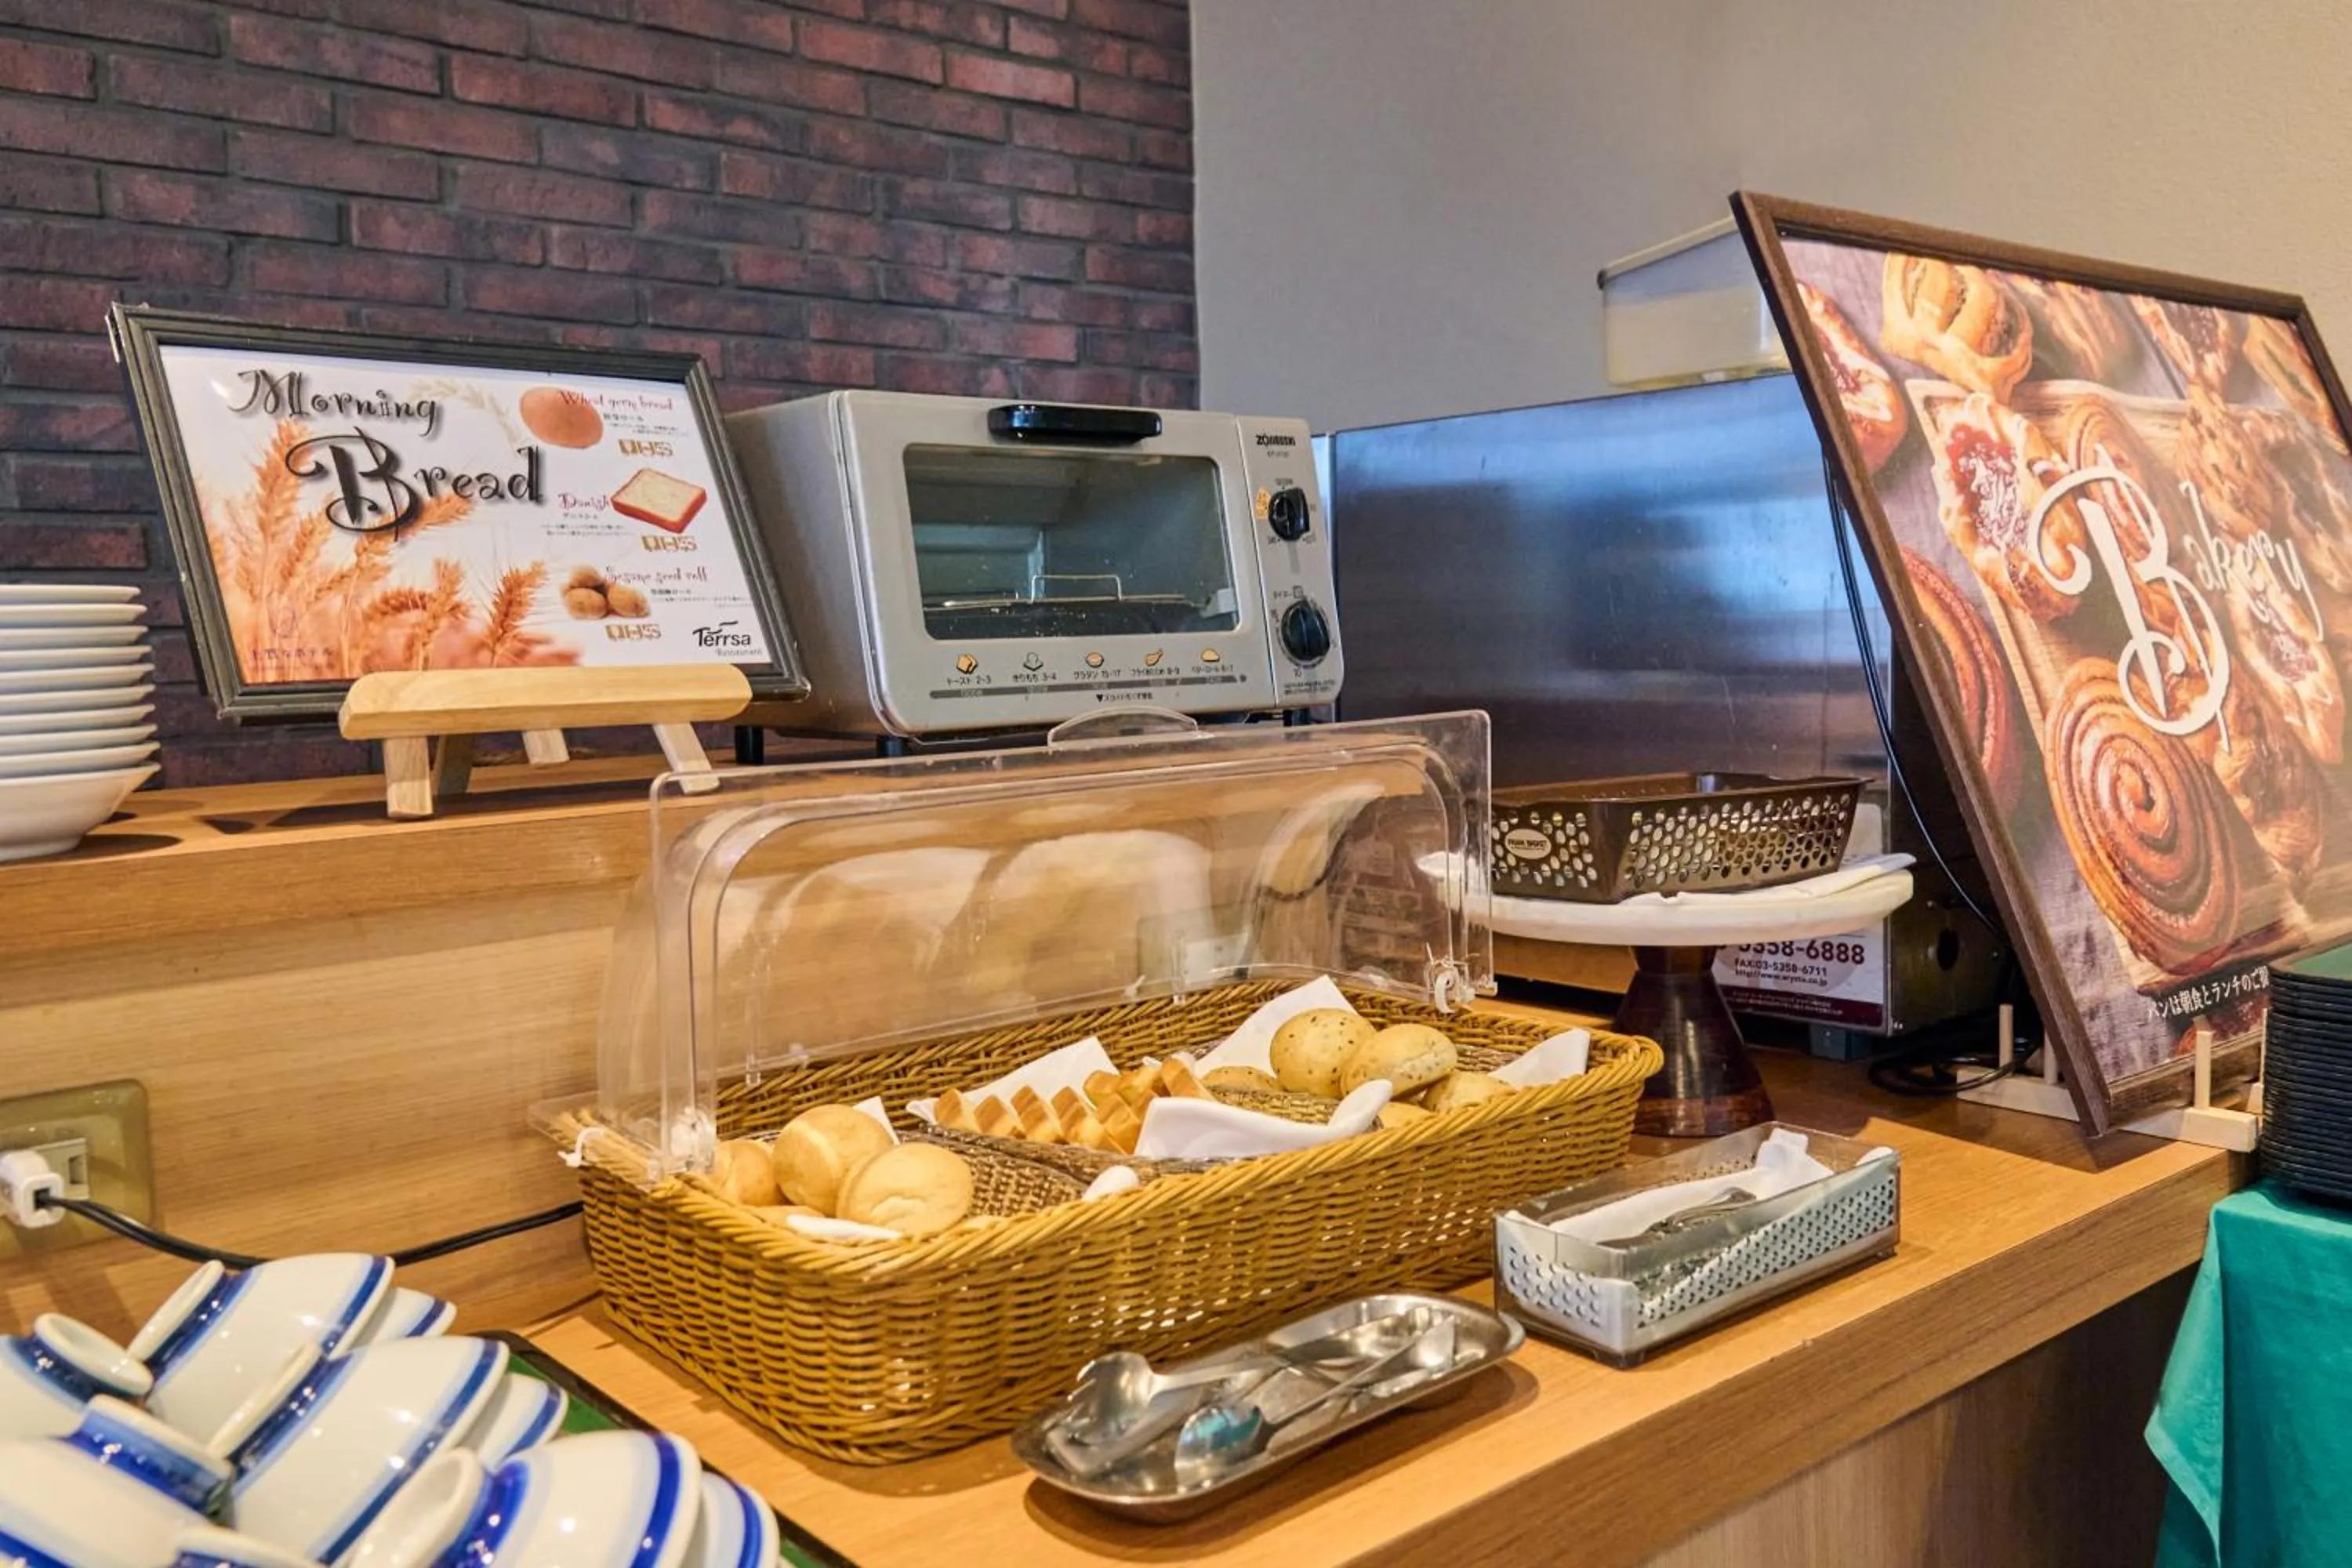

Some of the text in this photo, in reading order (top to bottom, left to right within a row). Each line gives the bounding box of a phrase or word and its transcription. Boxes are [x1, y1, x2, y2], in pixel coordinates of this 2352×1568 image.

[227, 368, 437, 437] Morning
[285, 426, 542, 542] Bread
[692, 621, 751, 647] Terrsa
[2028, 441, 2324, 754] Bakery
